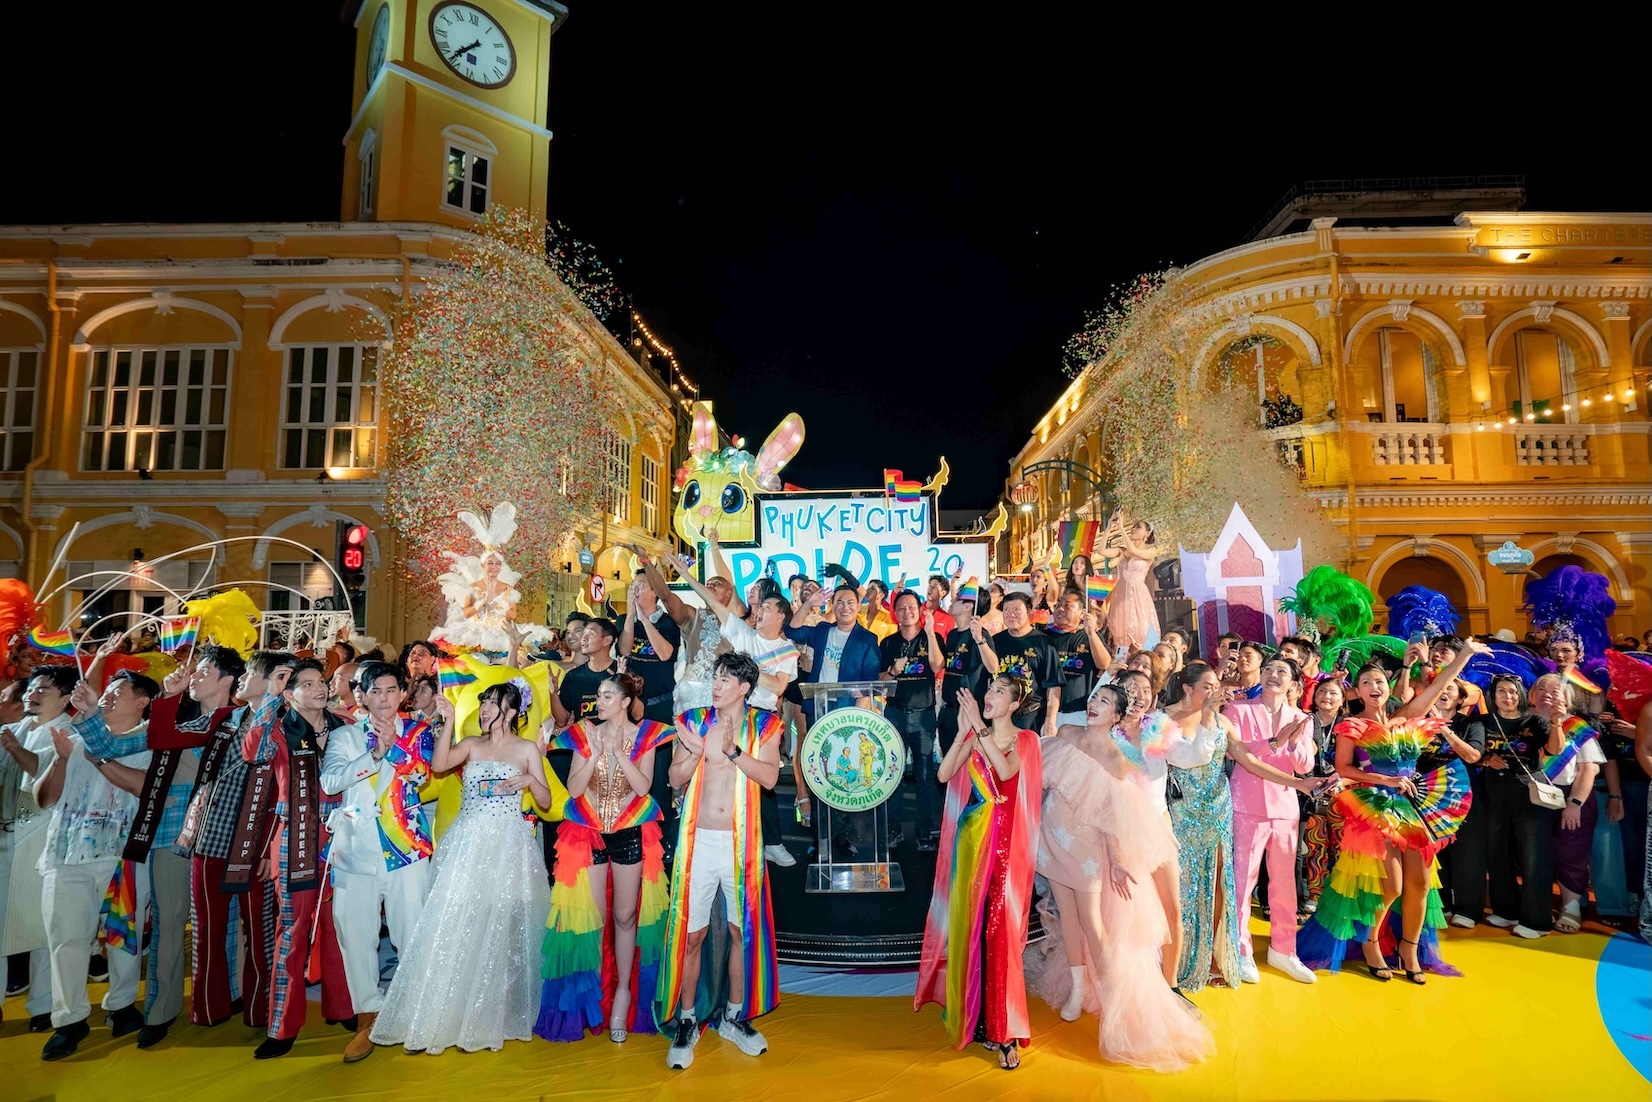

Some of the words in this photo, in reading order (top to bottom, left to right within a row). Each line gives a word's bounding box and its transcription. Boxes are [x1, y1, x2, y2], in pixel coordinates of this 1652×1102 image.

[1490, 227, 1532, 242] THE
[812, 714, 892, 745] เทศบาลนครภูเก็ต
[255, 765, 271, 774] 2nd
[299, 769, 307, 798] THE
[246, 777, 264, 831] RUNNER
[825, 786, 884, 809] จังหวัดภูเก็ต
[298, 804, 308, 859] WINNER
[240, 840, 251, 858] UP
